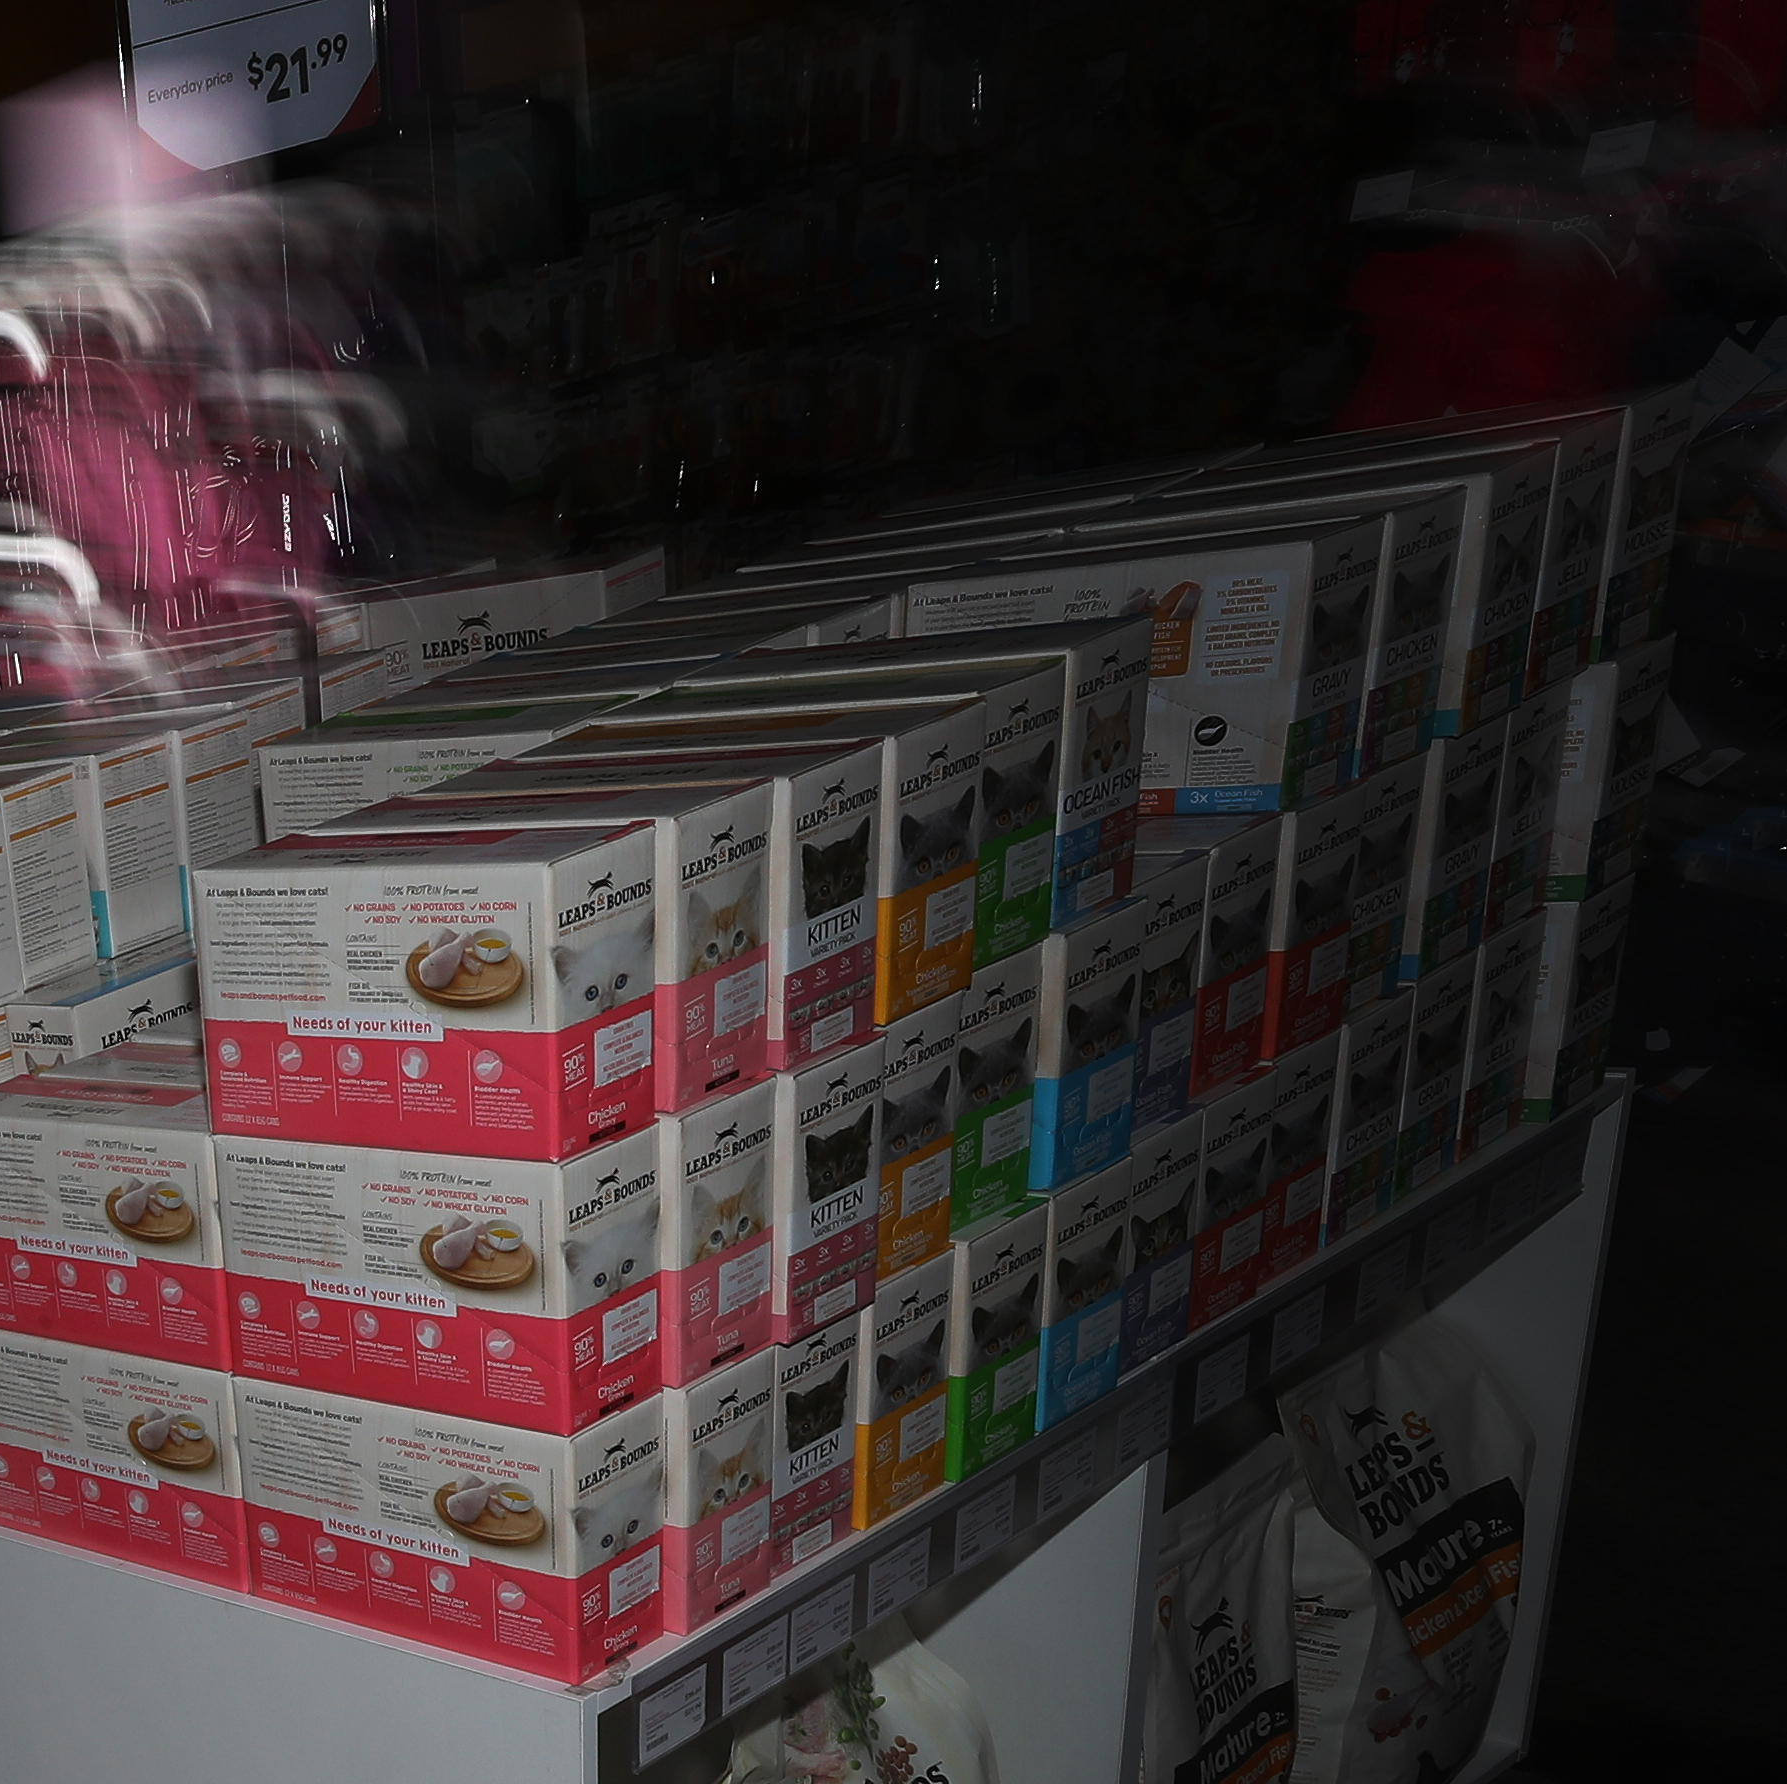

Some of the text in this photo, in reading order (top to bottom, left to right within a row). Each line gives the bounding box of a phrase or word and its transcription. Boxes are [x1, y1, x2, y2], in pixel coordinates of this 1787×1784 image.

[147, 33, 348, 104] Everyday price $21.99
[1558, 556, 1592, 587] JELLY
[422, 628, 548, 660] LEAPS BOUNDS
[1386, 631, 1439, 667] CHICKEN
[1311, 667, 1353, 698] GRAVY
[1063, 765, 1140, 815] OCEAN FISH
[1189, 790, 1210, 805] 3x
[796, 786, 879, 833] LEAPS BOUNDS
[1512, 806, 1544, 837] JELLY
[682, 831, 768, 882] LEAPS BOUNDS
[216, 887, 329, 899] Leaps Bounds love cats!
[366, 902, 517, 912] GRAINS POTATOES NO CORN
[558, 879, 653, 929] LEAPS BOUNDS
[1352, 884, 1402, 923] CHICKEN
[384, 915, 495, 924] SOY WHEAT GLUTEN
[808, 904, 861, 946] KITTEN
[293, 1016, 432, 1034] Needs of your kitten
[563, 1053, 585, 1074] 90%
[565, 1066, 586, 1084] MEAT
[711, 1053, 734, 1071] Tuna
[588, 1101, 626, 1125] Chicken
[810, 1186, 864, 1228] KITTEN
[20, 1235, 128, 1260] Needs of your kitten
[311, 1279, 446, 1309] Needs of your kitten
[598, 1373, 634, 1401] Chicken
[1402, 1411, 1432, 1440] &
[789, 1434, 839, 1476] KITTEN
[1190, 1619, 1251, 1701] LEAPS &
[1196, 1653, 1258, 1735] BOUNDS
